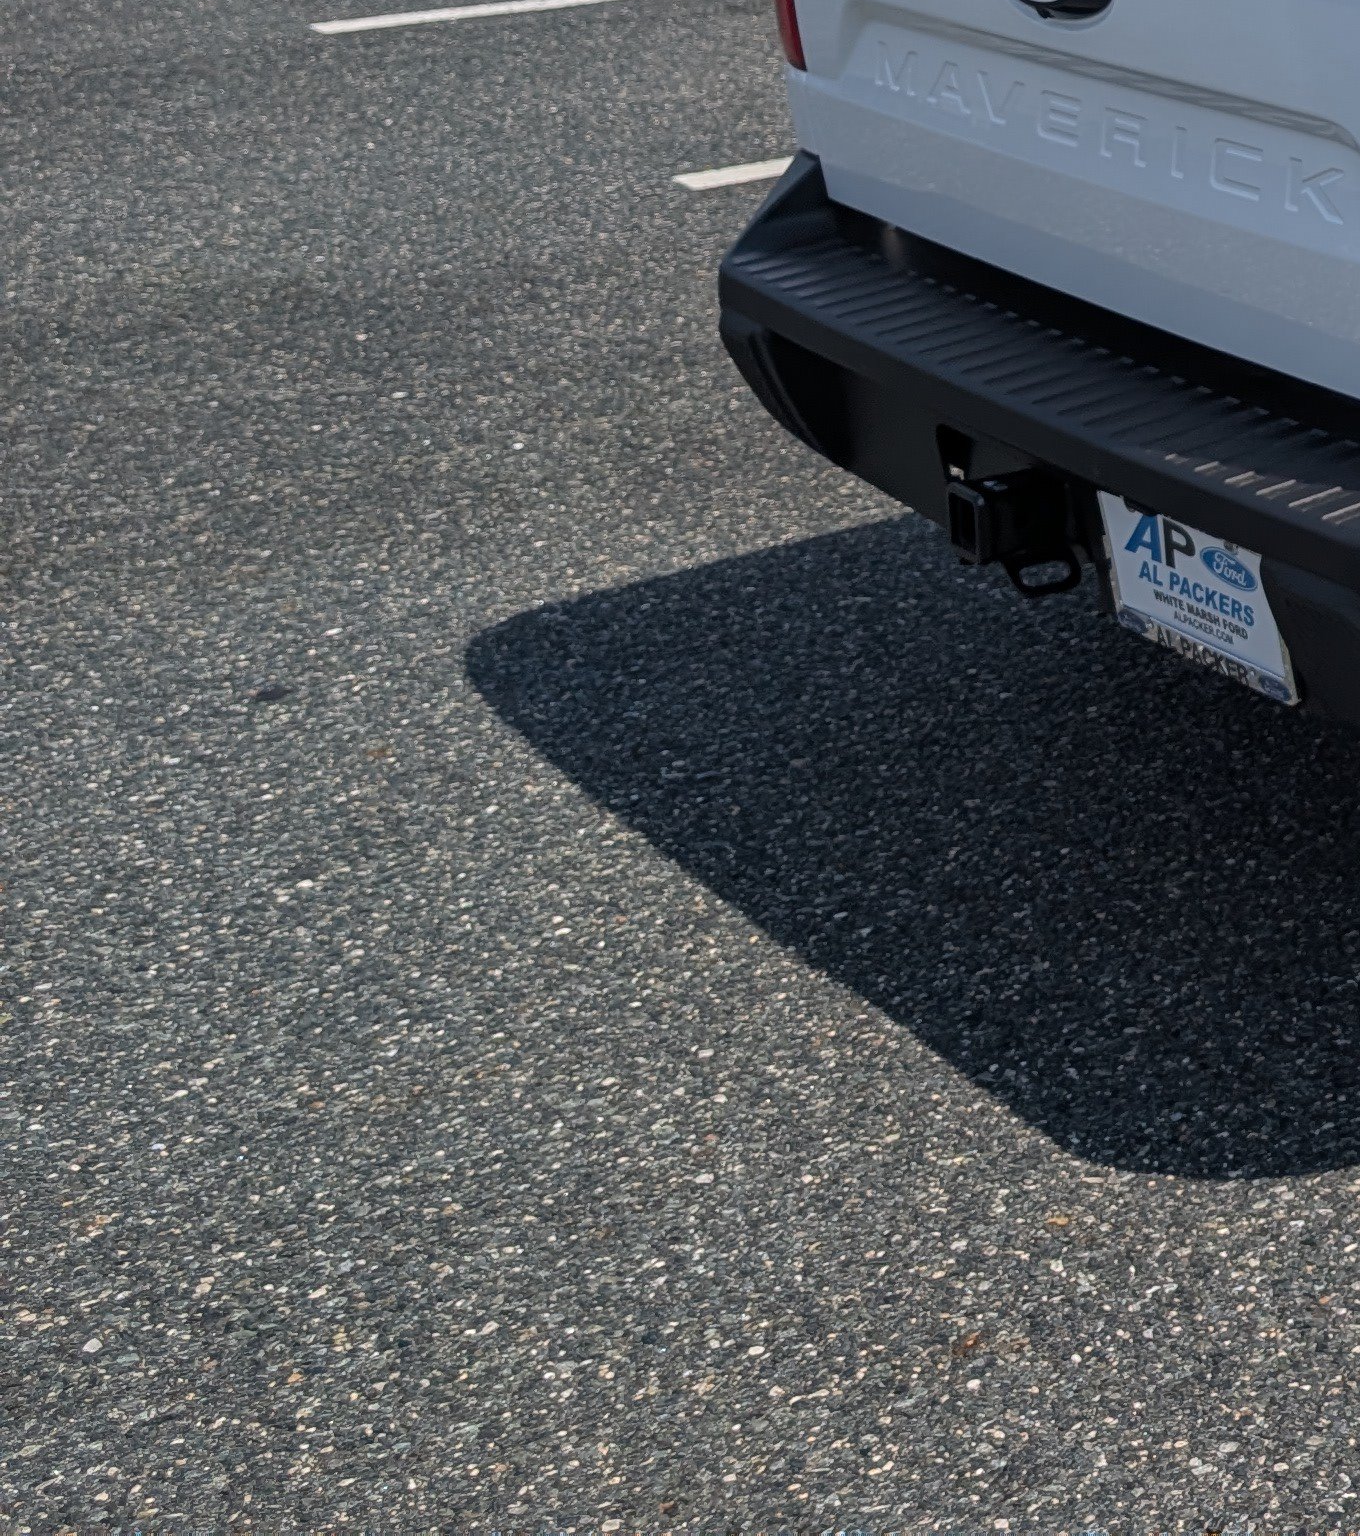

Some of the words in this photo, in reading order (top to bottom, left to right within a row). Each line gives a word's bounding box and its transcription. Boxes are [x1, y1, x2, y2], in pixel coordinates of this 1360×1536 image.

[873, 41, 1345, 226] MAVERICK
[1124, 514, 1196, 569] AP
[1211, 549, 1250, 589] Ford
[1138, 560, 1164, 588] AL
[1169, 570, 1256, 627] PACKERS
[1153, 588, 1186, 612] WHITE
[1186, 602, 1221, 626] MARSH
[1222, 618, 1249, 640] FORD
